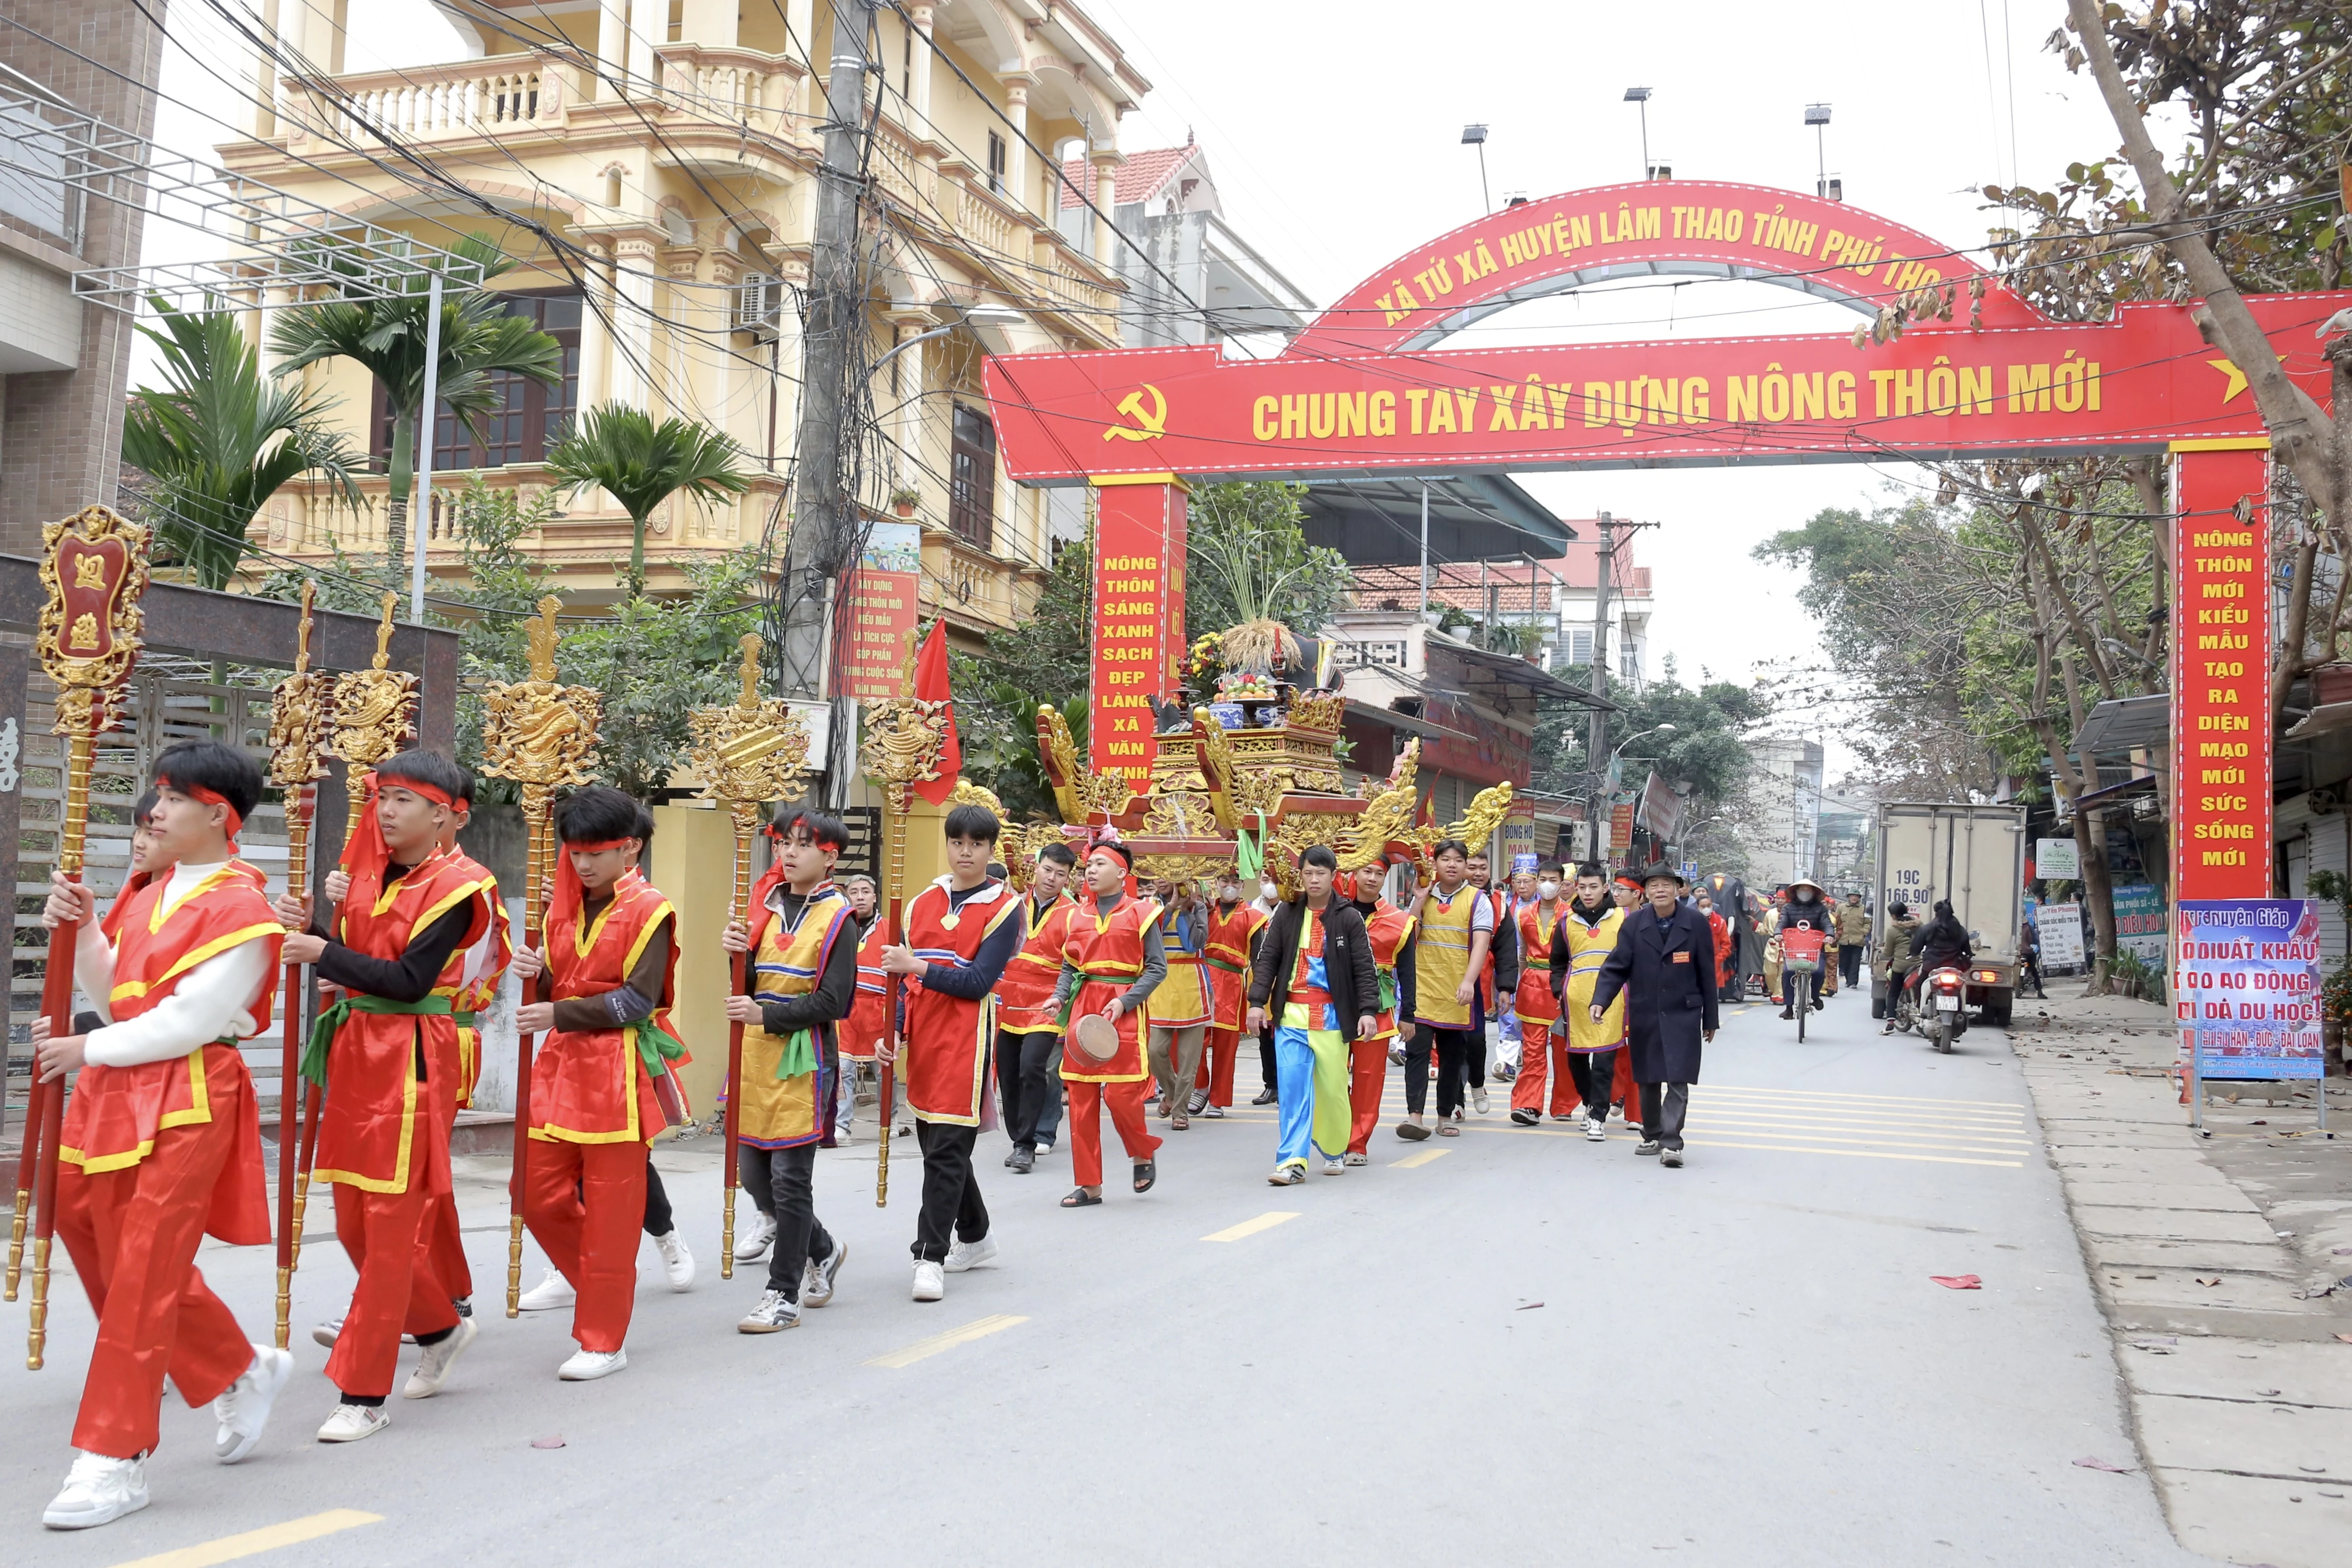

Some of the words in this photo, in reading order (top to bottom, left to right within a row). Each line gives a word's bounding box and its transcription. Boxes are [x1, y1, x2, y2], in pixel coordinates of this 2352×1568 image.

[1374, 278, 1422, 327] XÃ
[1413, 256, 1454, 303] TỨ
[1454, 239, 1499, 284] XÃ
[1500, 213, 1592, 258] HUYỆN
[1600, 202, 1661, 244] LÂM
[1671, 206, 1744, 242] THAO
[1752, 204, 1819, 256] TỈNH
[1819, 229, 1885, 276] PHÚ
[1253, 390, 1396, 440] CHUNG
[1405, 387, 1480, 434] TAY
[1489, 374, 1572, 431] XÂY
[1585, 375, 1710, 437] DỰNG
[1727, 363, 1856, 422] NÔNG
[1869, 356, 1992, 417] THÔN
[2008, 350, 2100, 413] MỚI
[2194, 530, 2252, 547] NÔNG
[1105, 556, 1156, 570] NÔNG
[2196, 556, 2251, 572] THÔN
[858, 578, 871, 589] XÂY
[873, 580, 892, 593] DỰNG
[1106, 577, 1154, 592] THÔN
[2203, 580, 2243, 597] MỚI
[869, 596, 887, 608] THÔN
[889, 597, 902, 610] MỚI
[1104, 600, 1154, 615] SÁNG
[858, 611, 873, 625] KIỂU
[876, 612, 891, 626] MẪU
[2199, 603, 2248, 623] KIỂU
[853, 629, 861, 641] LÀ
[864, 630, 879, 642] TÍCH
[881, 632, 895, 645] CỰC
[1103, 625, 1153, 637] XANH
[2200, 629, 2248, 649] MẪU
[856, 647, 870, 659] GÓP
[1103, 648, 1152, 663] SẠCH
[866, 665, 885, 680] CUỘC
[2205, 663, 2243, 678] TẠO
[1109, 672, 1145, 686] ĐẸP
[855, 682, 869, 694] VĂN
[1103, 692, 1150, 707] LÀNG
[2209, 690, 2237, 702] RA
[1114, 717, 1139, 731] XÃ
[2199, 713, 2248, 733] DIỆN
[1109, 740, 1144, 755] VĂN
[2201, 744, 2248, 759] MẠO
[2203, 766, 2244, 783] MỚI
[2202, 793, 2246, 811] SỨC
[2195, 819, 2253, 838] SỐNG
[1508, 842, 1529, 855] MÁY
[2203, 848, 2245, 865] MỚI
[1896, 870, 1919, 884] 19C
[1887, 888, 1928, 904] 166.90
[2257, 907, 2288, 928] Giáp
[2261, 935, 2316, 960] KHẨU
[2254, 970, 2310, 994] ĐỘNG
[2239, 1003, 2265, 1020] DU
[2274, 1003, 2313, 1026] HỌC
[2230, 1027, 2248, 1047] HÀN
[2256, 1028, 2273, 1048] ĐỨC
[2281, 1029, 2295, 1048] ĐÀI
[2297, 1032, 2320, 1048] LOAN
